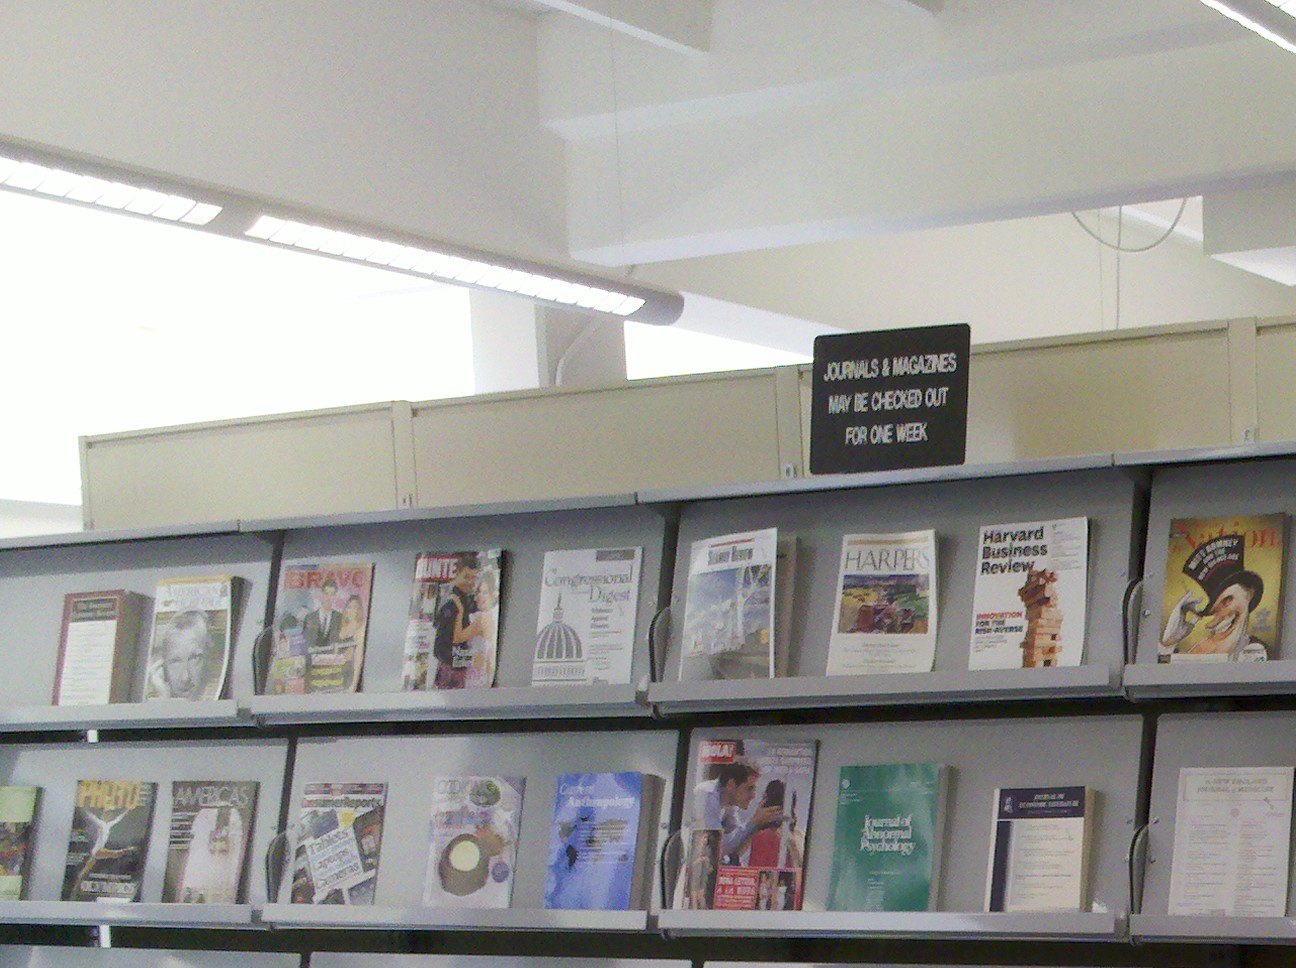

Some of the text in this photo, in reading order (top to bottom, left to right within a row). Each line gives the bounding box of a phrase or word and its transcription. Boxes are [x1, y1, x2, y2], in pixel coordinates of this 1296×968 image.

[824, 353, 957, 382] JOURNALS & MAGAZINES
[829, 387, 949, 414] MAY BE CHECKED OUT
[845, 422, 928, 445] FOR ONE WEEK
[983, 526, 1044, 544] Harvard
[982, 542, 1048, 560] Business
[981, 559, 1035, 575] Review
[864, 813, 911, 830] Journal of
[861, 826, 912, 840] Abnormal
[860, 838, 916, 856] Psychology
